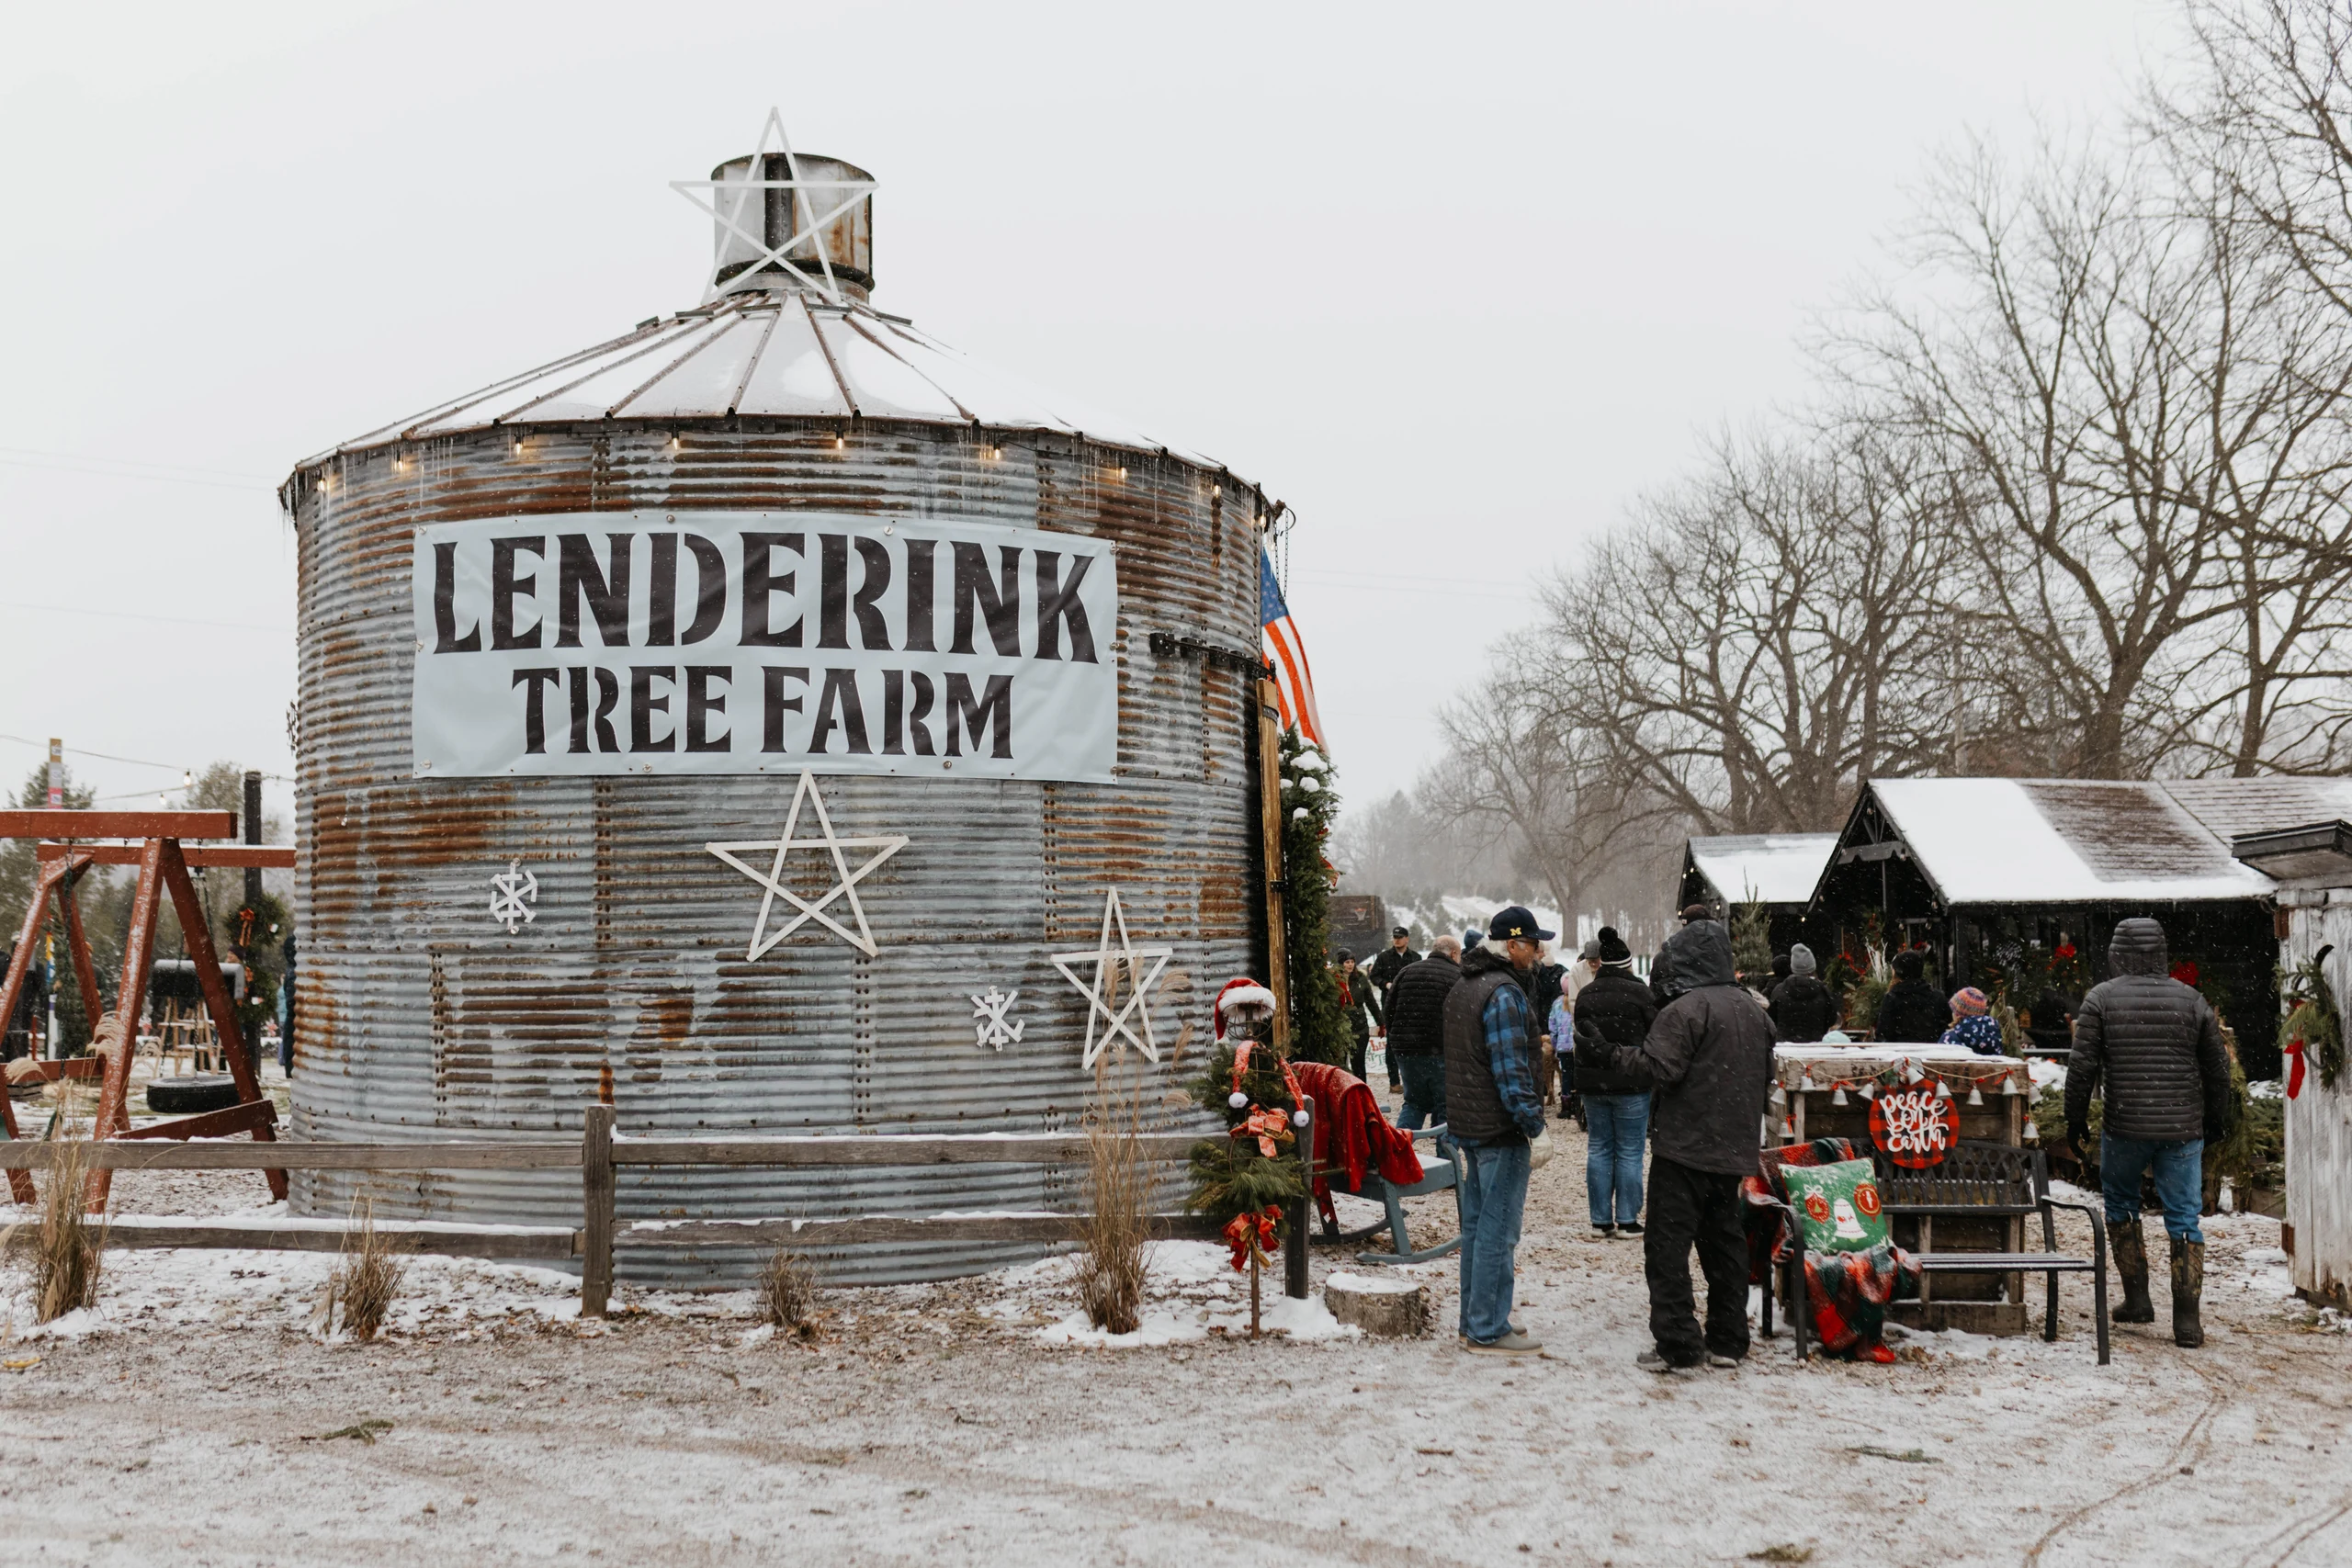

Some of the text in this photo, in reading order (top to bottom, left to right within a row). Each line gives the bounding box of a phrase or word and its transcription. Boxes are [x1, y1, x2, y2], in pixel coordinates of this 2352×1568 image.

[433, 532, 1100, 664] LENDERINK
[512, 665, 1015, 760] TREE FARM
[1510, 927, 1522, 937] M
[1879, 1090, 1948, 1124] peace
[1900, 1108, 1928, 1130] on
